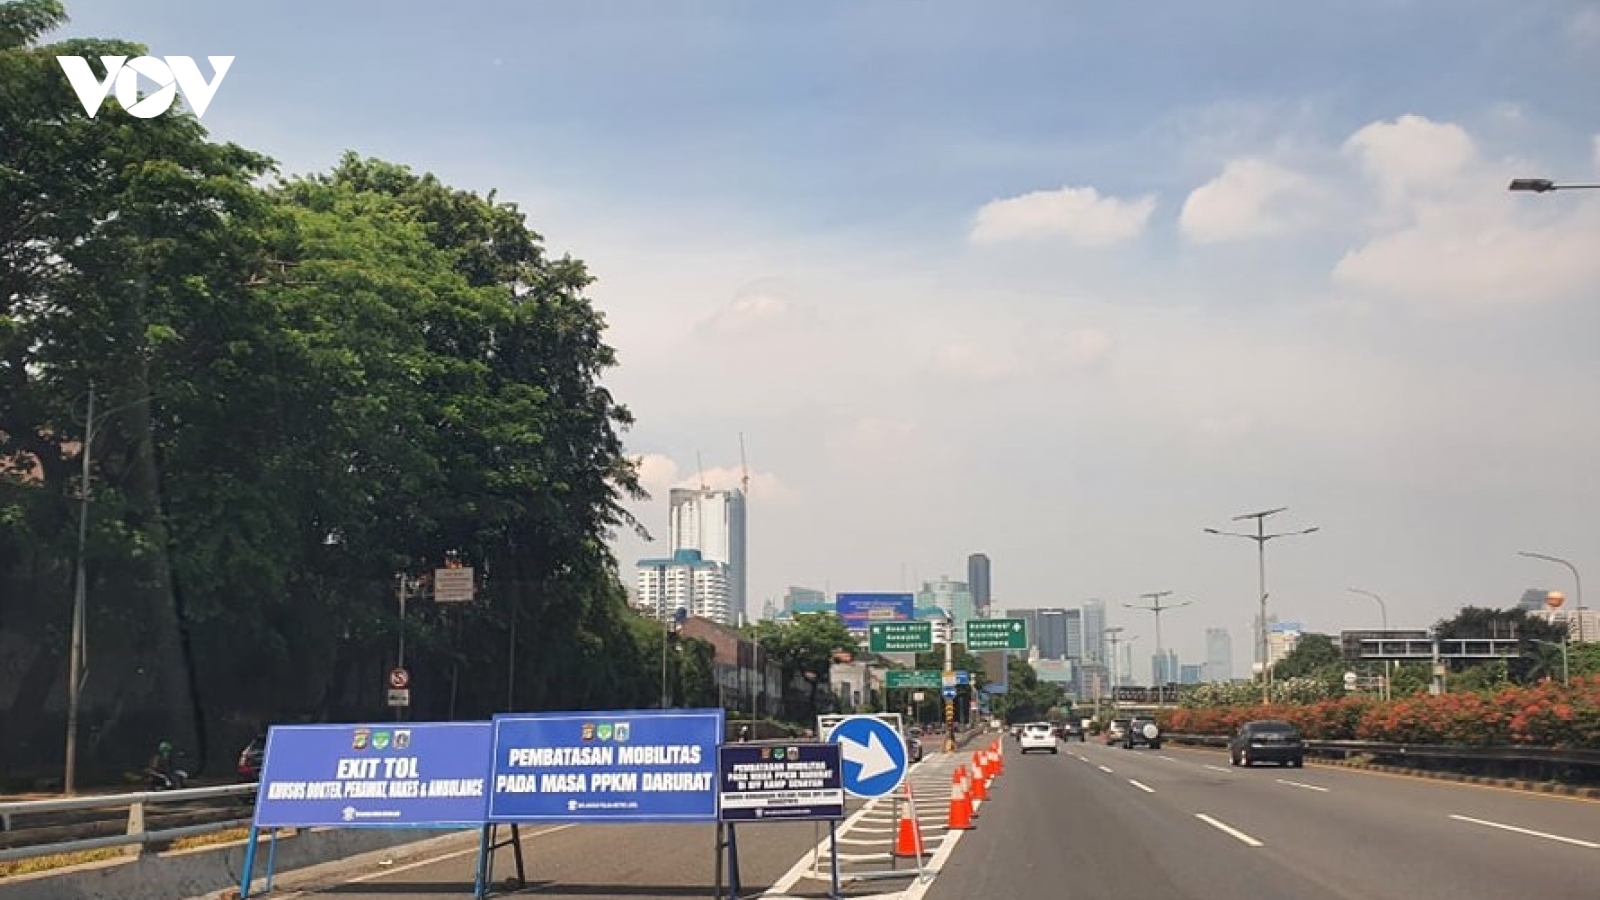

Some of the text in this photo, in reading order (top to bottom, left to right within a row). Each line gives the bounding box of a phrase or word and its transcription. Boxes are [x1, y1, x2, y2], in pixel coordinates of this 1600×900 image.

[509, 745, 702, 767] PEMBATASAN MOBILITAS
[336, 757, 420, 779] EXIT TOL
[427, 778, 484, 797] AMBULANCE
[496, 772, 713, 793] PADA MASA PPKM DARURAT
